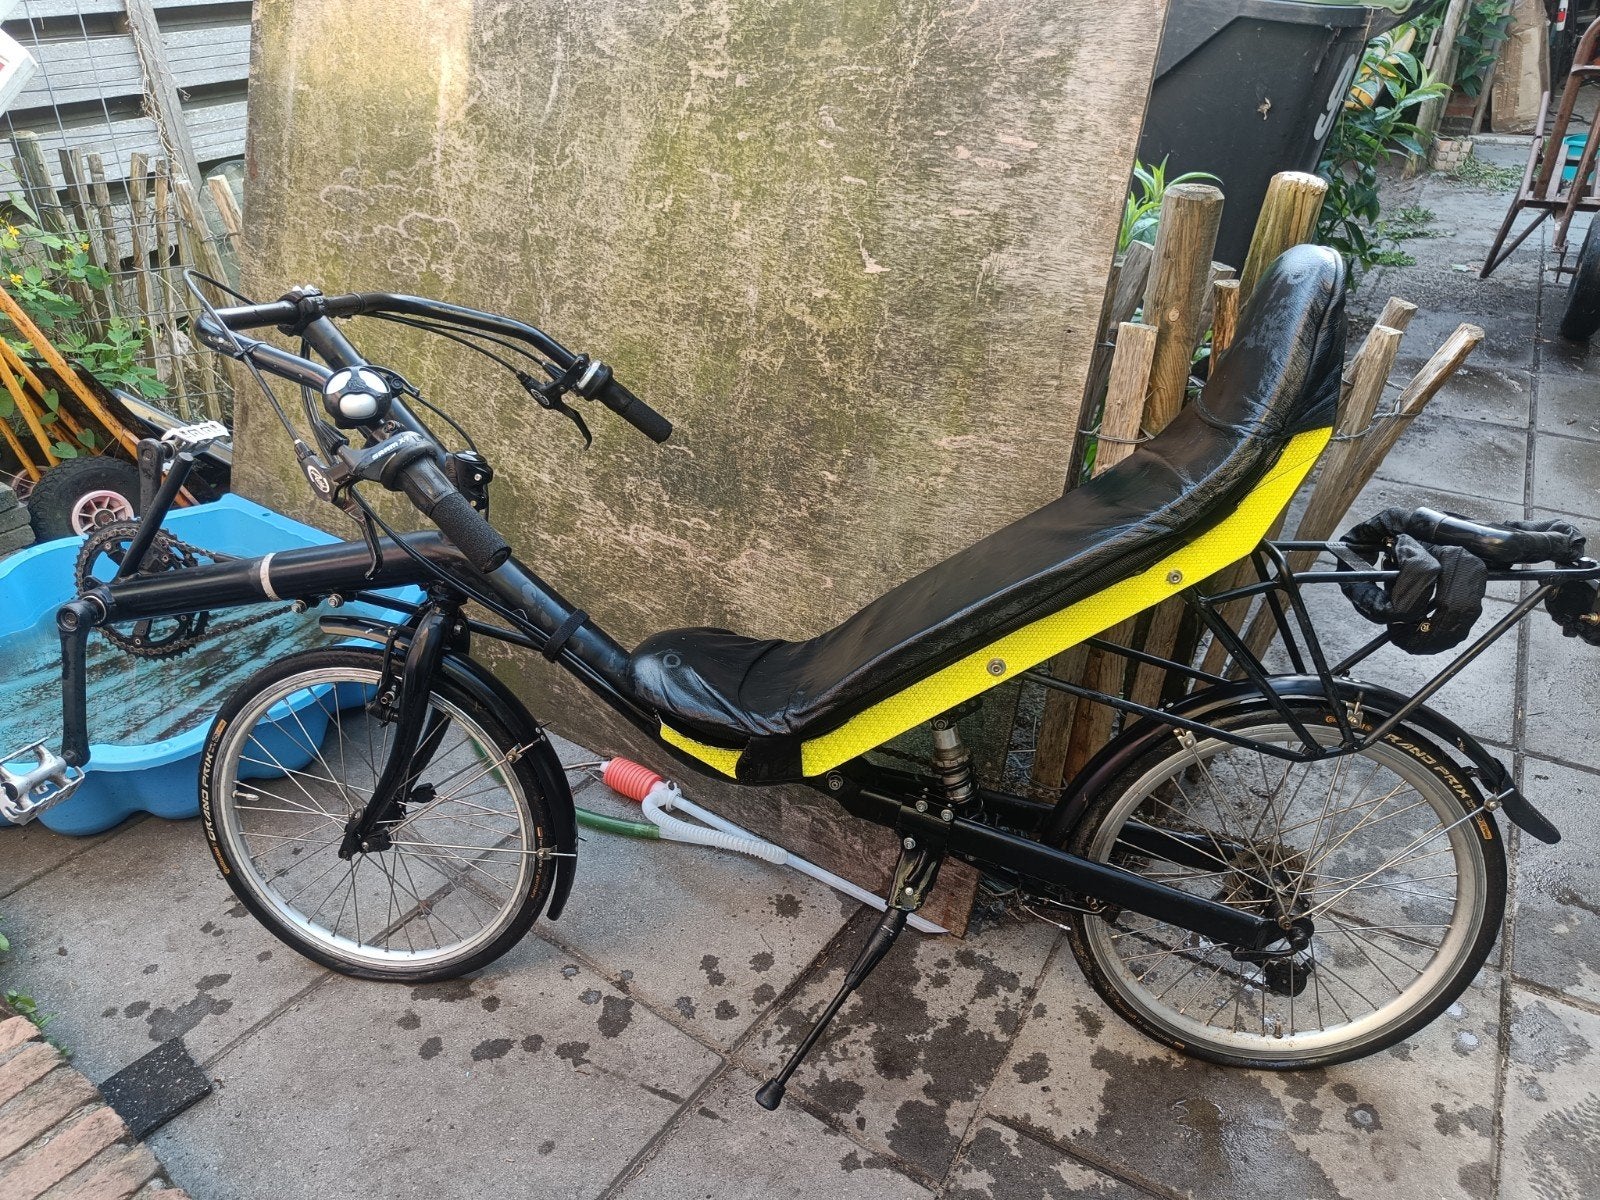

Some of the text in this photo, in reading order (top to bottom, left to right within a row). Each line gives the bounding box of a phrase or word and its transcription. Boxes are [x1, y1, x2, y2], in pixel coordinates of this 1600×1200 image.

[1313, 53, 1355, 141] 9
[201, 752, 217, 841] GRAND PRIX
[1383, 732, 1472, 799] RAND PRIX
